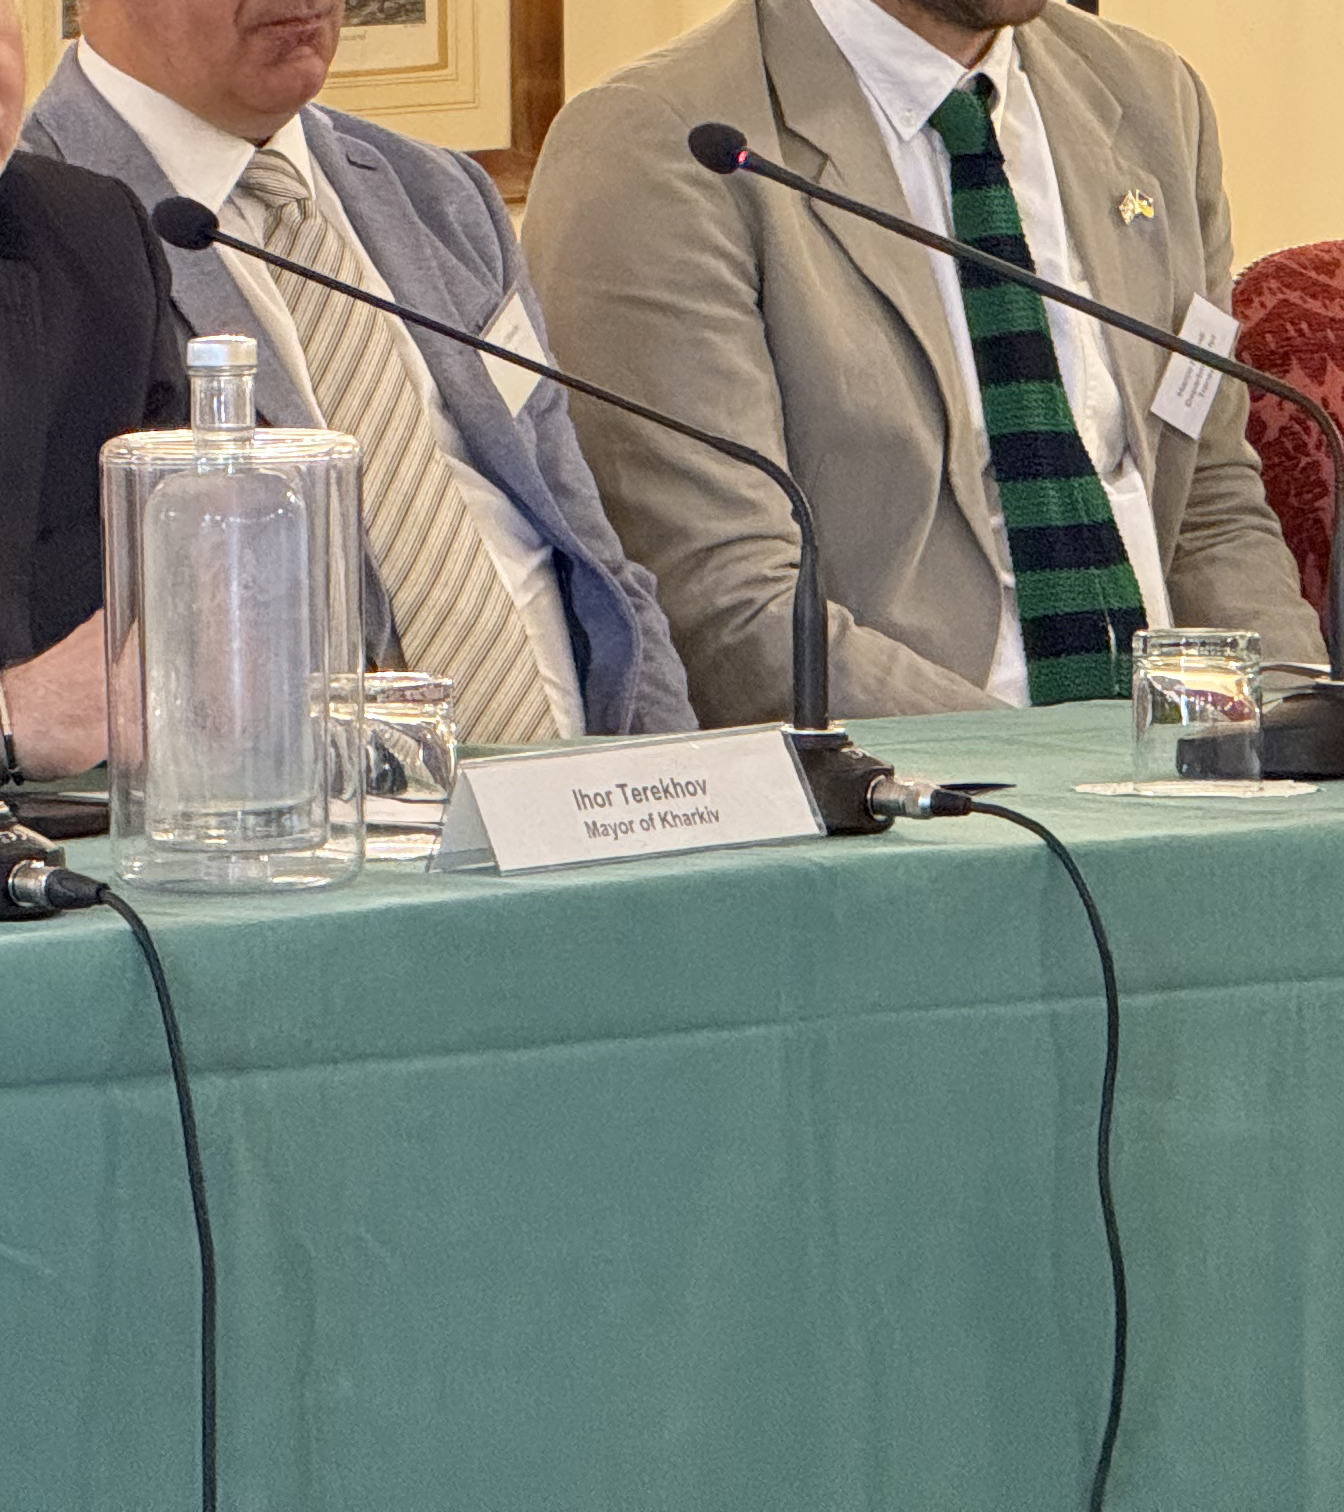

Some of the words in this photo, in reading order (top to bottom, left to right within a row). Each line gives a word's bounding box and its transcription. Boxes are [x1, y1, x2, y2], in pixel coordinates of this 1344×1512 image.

[572, 788, 613, 811] Ihor
[615, 777, 708, 806] Terekhov
[584, 818, 635, 840] Mayor
[639, 813, 657, 830] of
[659, 806, 720, 828] Kharkiv
